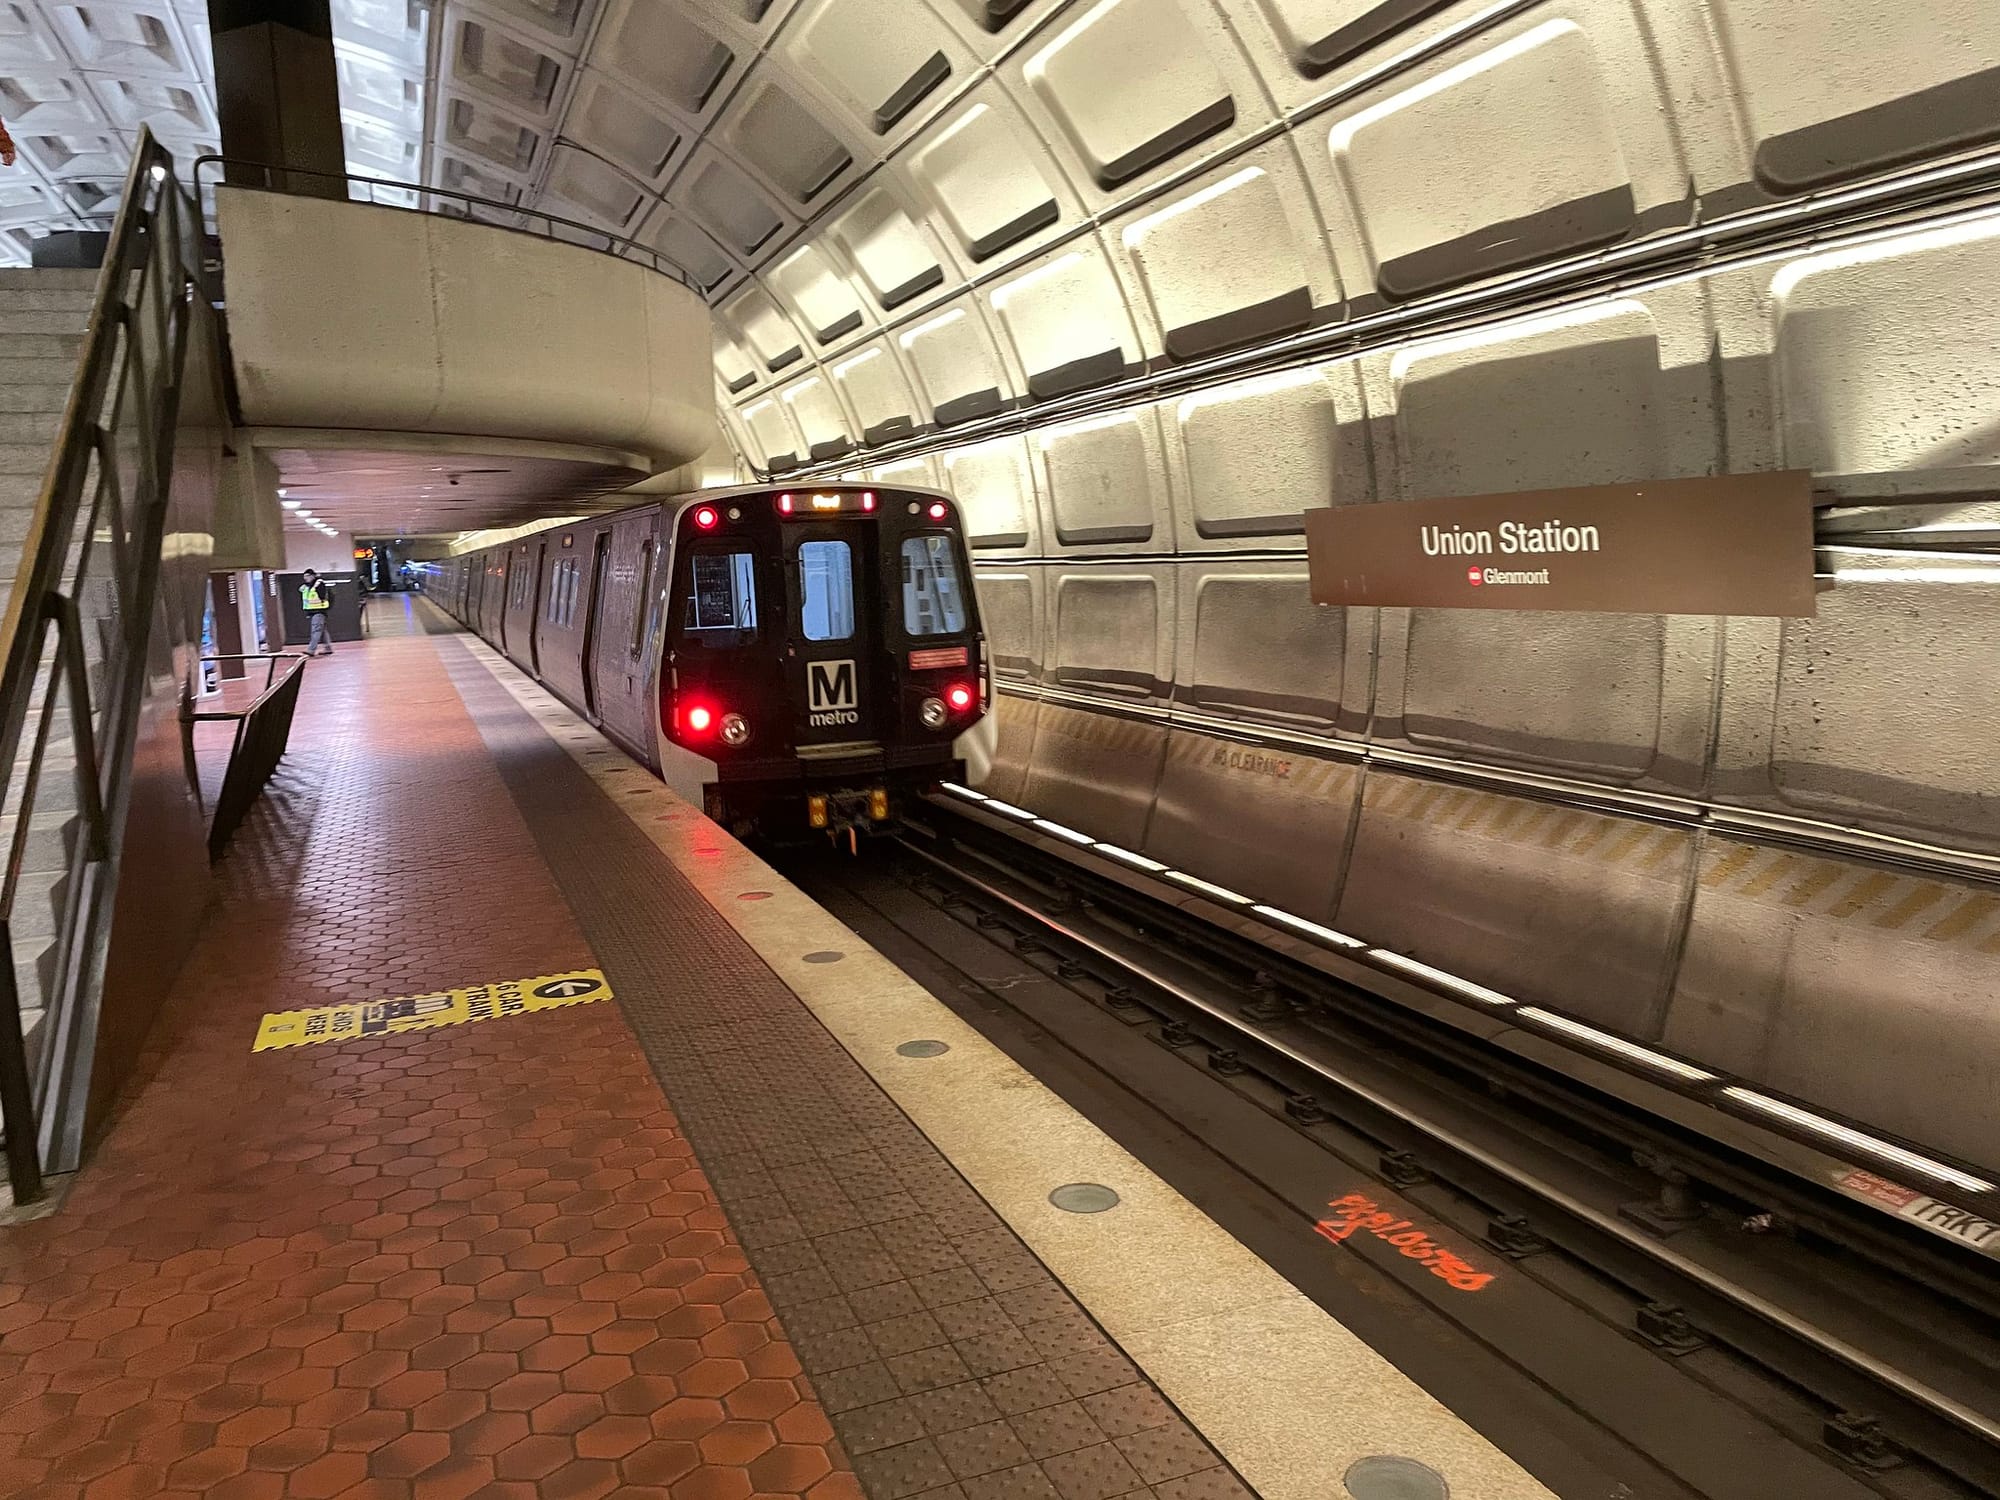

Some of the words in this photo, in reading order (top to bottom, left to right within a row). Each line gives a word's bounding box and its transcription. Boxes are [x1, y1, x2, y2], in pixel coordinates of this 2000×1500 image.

[1420, 524, 1493, 556] Union
[1499, 520, 1600, 555] Station
[1483, 567, 1550, 585] Glenmont
[811, 663, 853, 707] M
[809, 710, 859, 728] metro
[466, 987, 494, 1018] TRAIN
[497, 991, 525, 1012] CAR
[304, 1014, 328, 1037] HERE
[332, 1011, 354, 1033] ENDS
